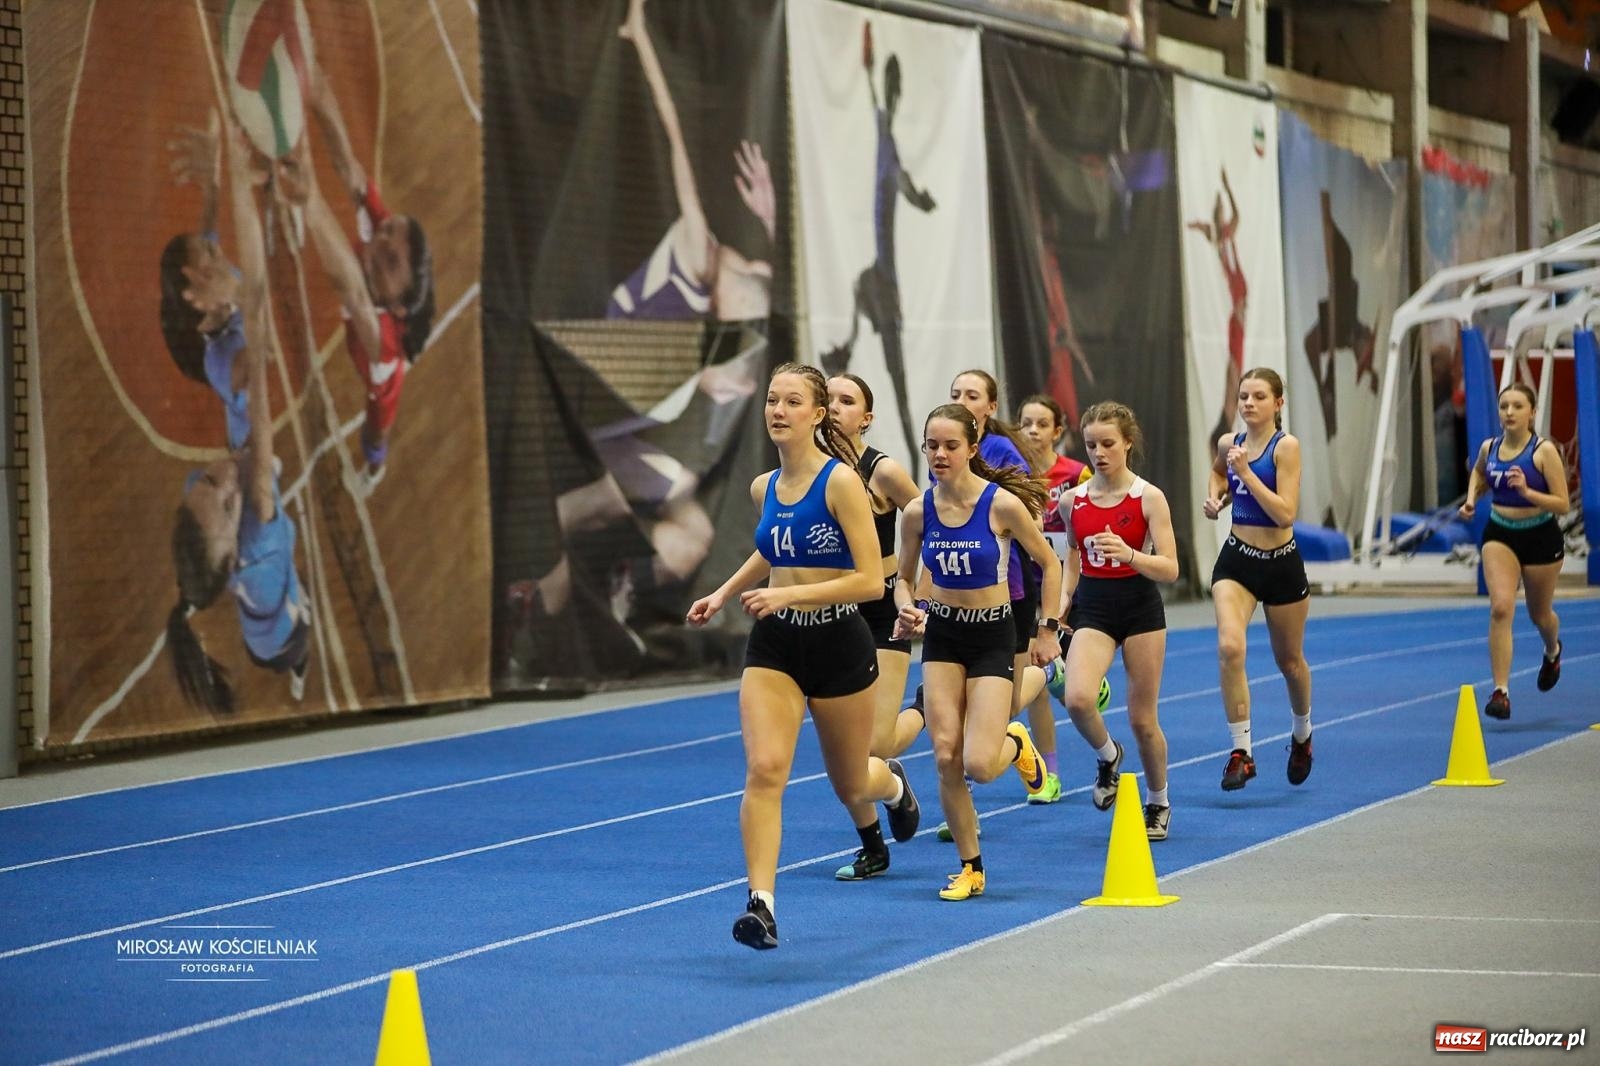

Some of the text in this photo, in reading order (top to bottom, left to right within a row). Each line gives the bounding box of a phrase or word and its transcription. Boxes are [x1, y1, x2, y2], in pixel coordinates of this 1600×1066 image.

[1232, 474, 1252, 495] 2
[771, 525, 796, 558] 14
[928, 541, 981, 549] MYSŁOWICE
[1239, 539, 1297, 559] NIKE PRO
[936, 551, 972, 576] 141
[791, 605, 832, 626] NIKE
[956, 606, 1001, 623] NIKE
